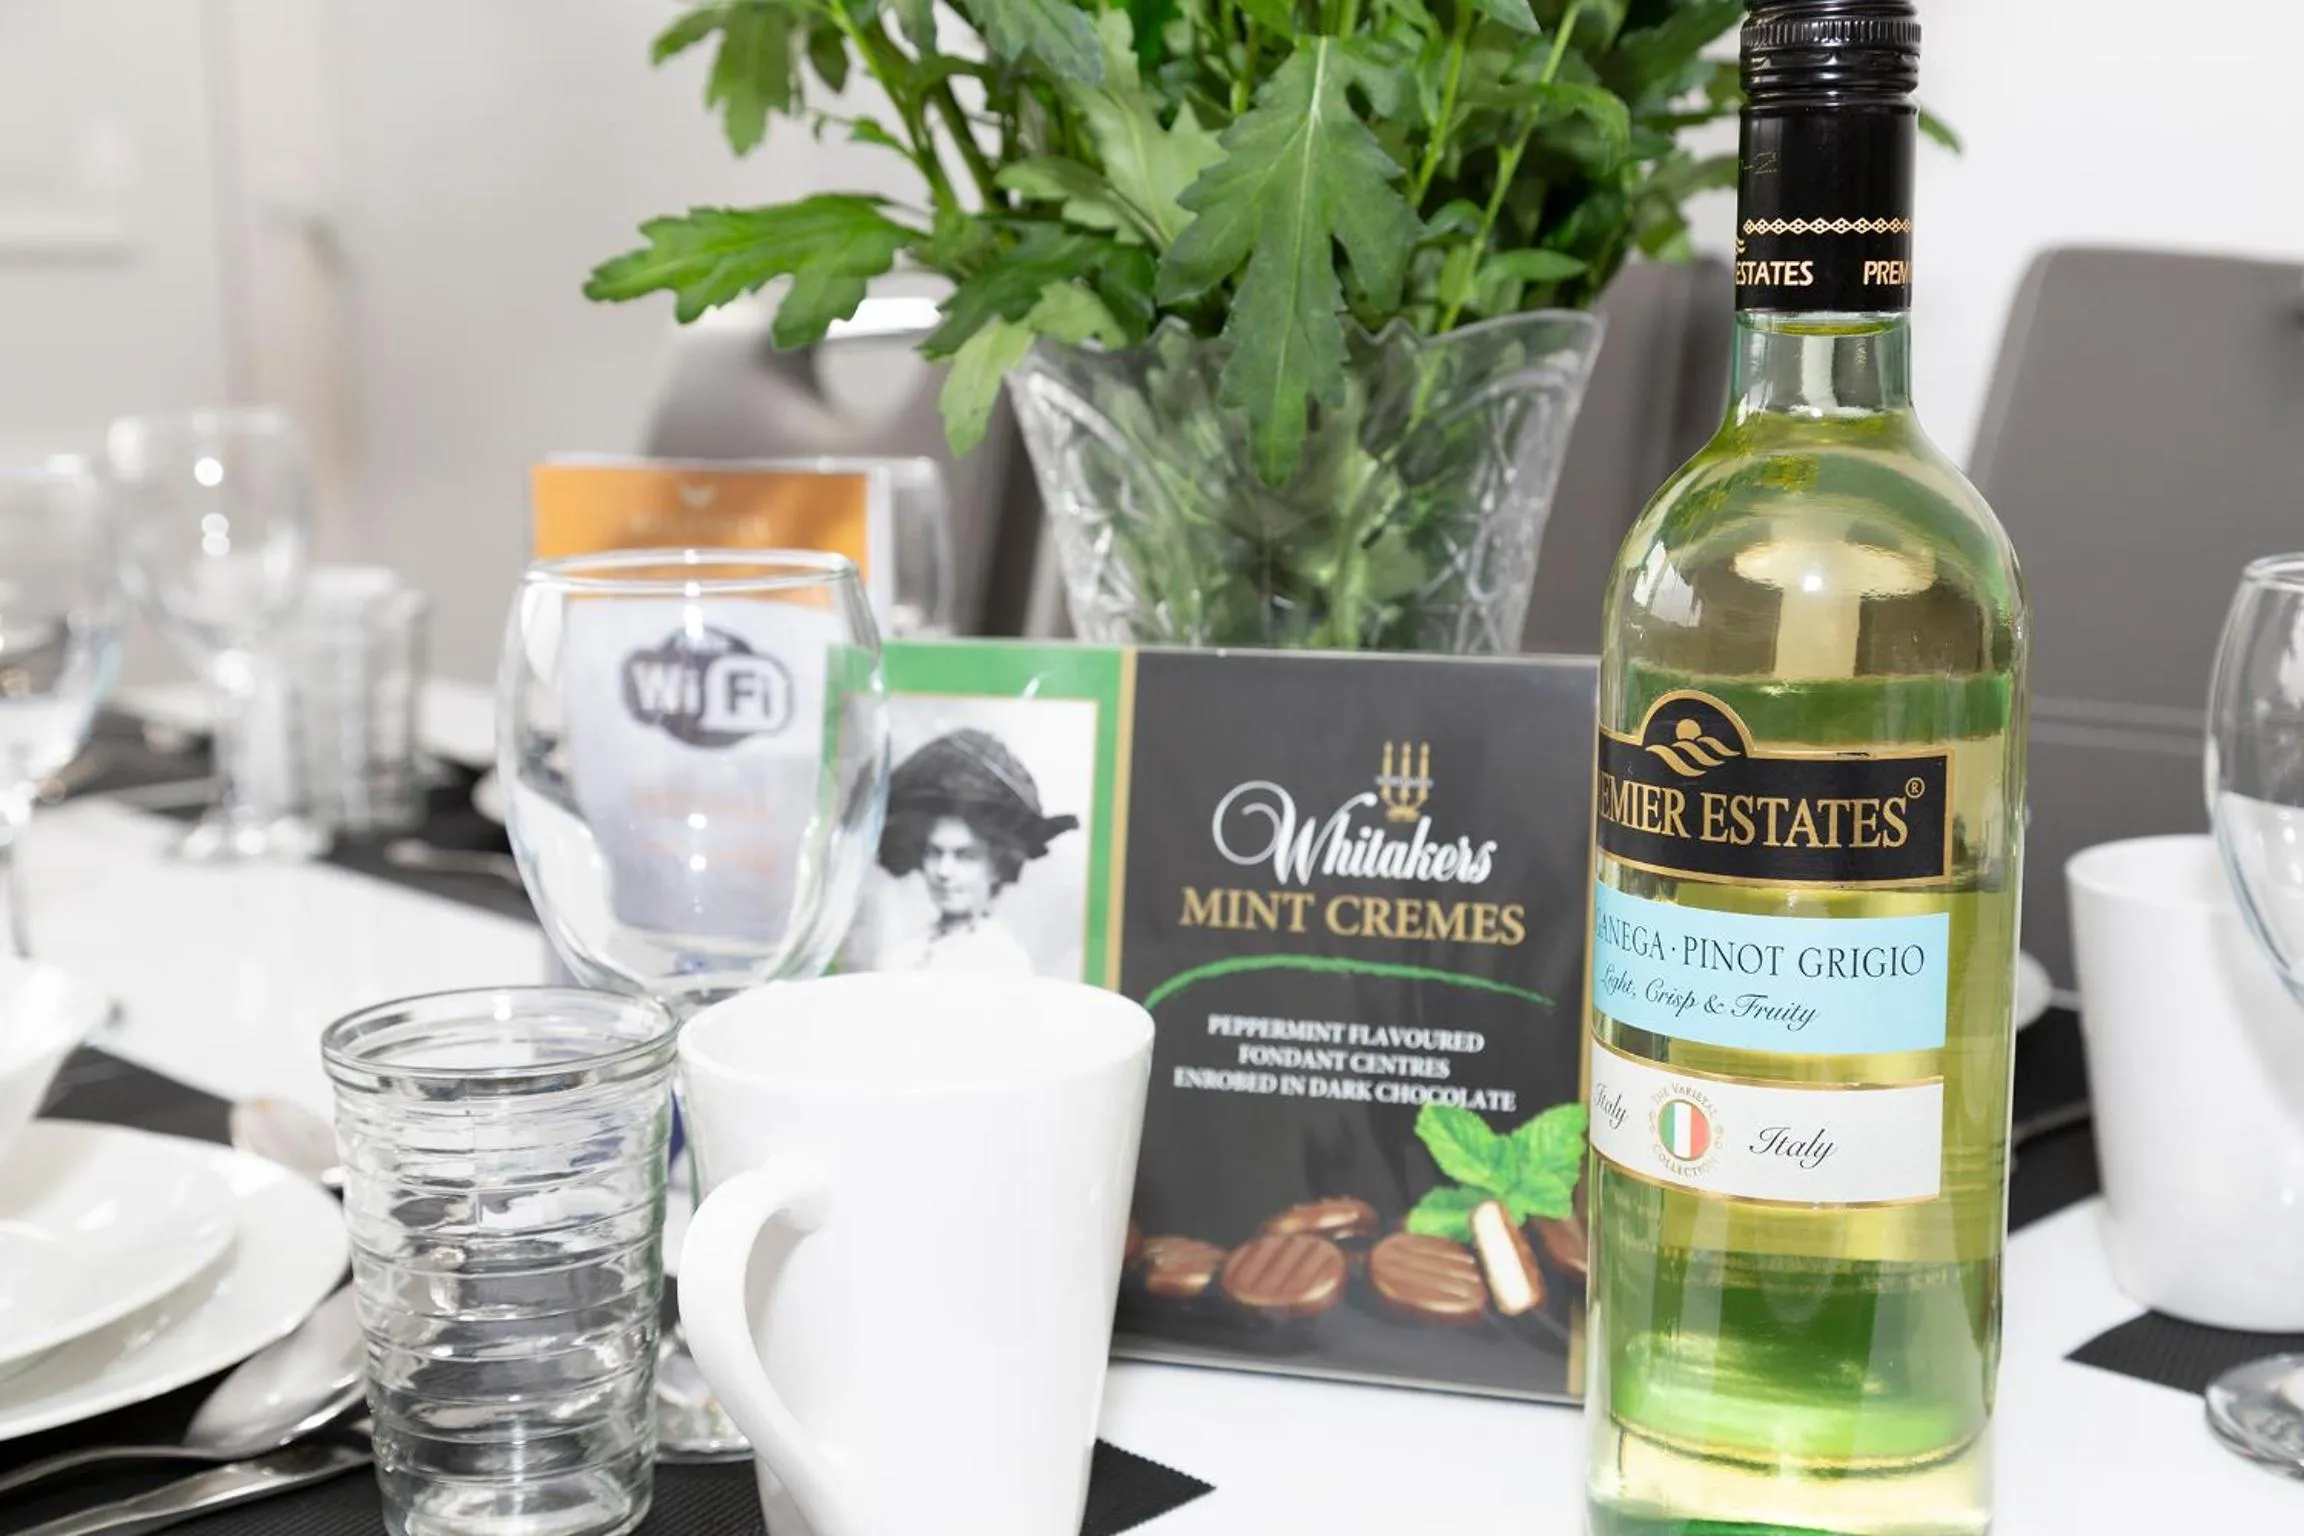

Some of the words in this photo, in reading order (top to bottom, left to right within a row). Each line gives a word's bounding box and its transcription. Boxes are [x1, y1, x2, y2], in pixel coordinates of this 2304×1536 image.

[1212, 780, 1498, 886] Whitakers
[1179, 886, 1315, 933] MINT
[1325, 894, 1527, 946] CREMES
[1683, 934, 1785, 977] PINOT
[1798, 944, 1925, 979] GRIGIO
[1645, 977, 1698, 1018] Crisp
[1703, 993, 1725, 1015] &
[1731, 993, 1819, 1032] Fruity
[1207, 1014, 1345, 1044] PEPPERMINT
[1349, 1022, 1486, 1054] FLAVOURED
[1238, 1043, 1347, 1072] FONDANT
[1350, 1052, 1451, 1080] CENTRES
[1173, 1066, 1278, 1094] ENROBED
[1280, 1074, 1307, 1097] IN
[1308, 1075, 1374, 1102] DARK
[1373, 1080, 1517, 1113] CHOCOLATE
[1748, 1126, 1836, 1169] Italy
